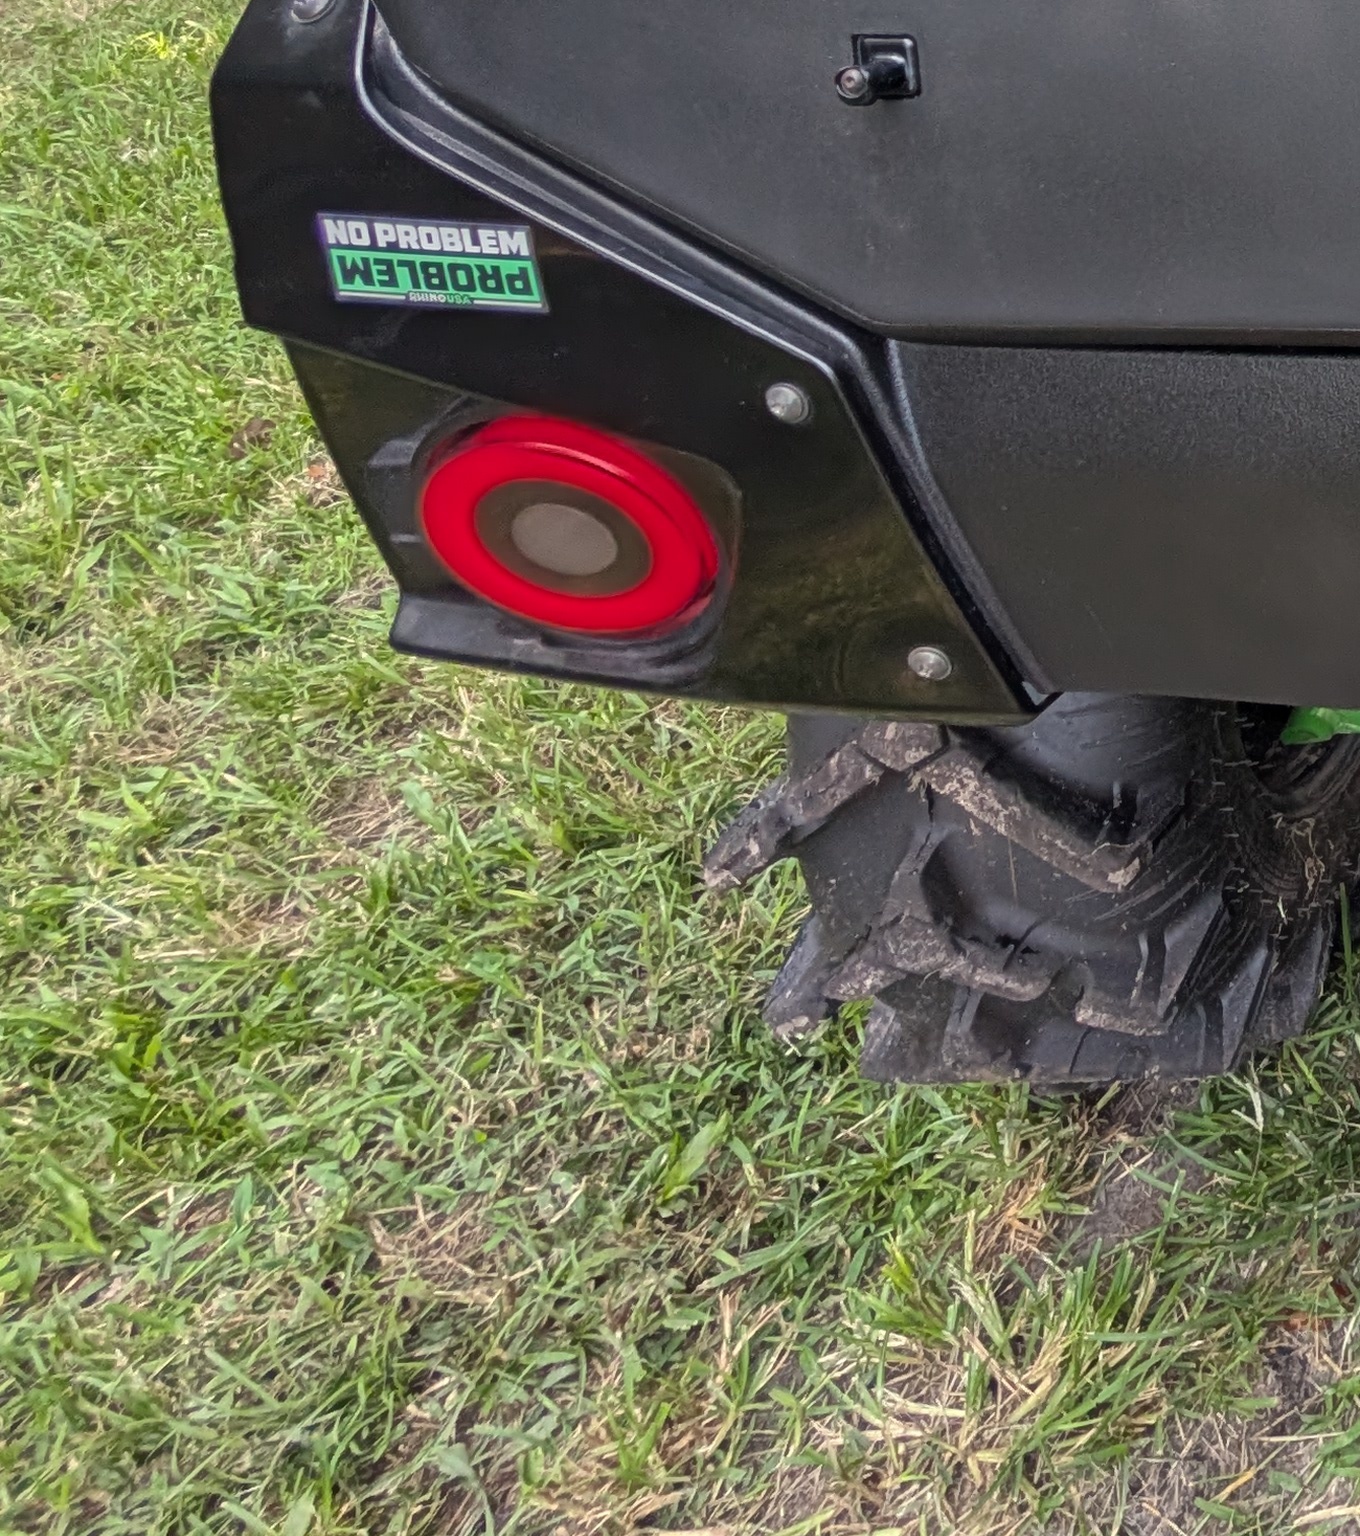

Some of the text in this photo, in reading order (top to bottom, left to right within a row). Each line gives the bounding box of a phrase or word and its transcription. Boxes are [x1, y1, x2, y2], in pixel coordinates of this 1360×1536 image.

[323, 218, 530, 257] NO PROBLEM
[335, 254, 535, 297] PROBLEM
